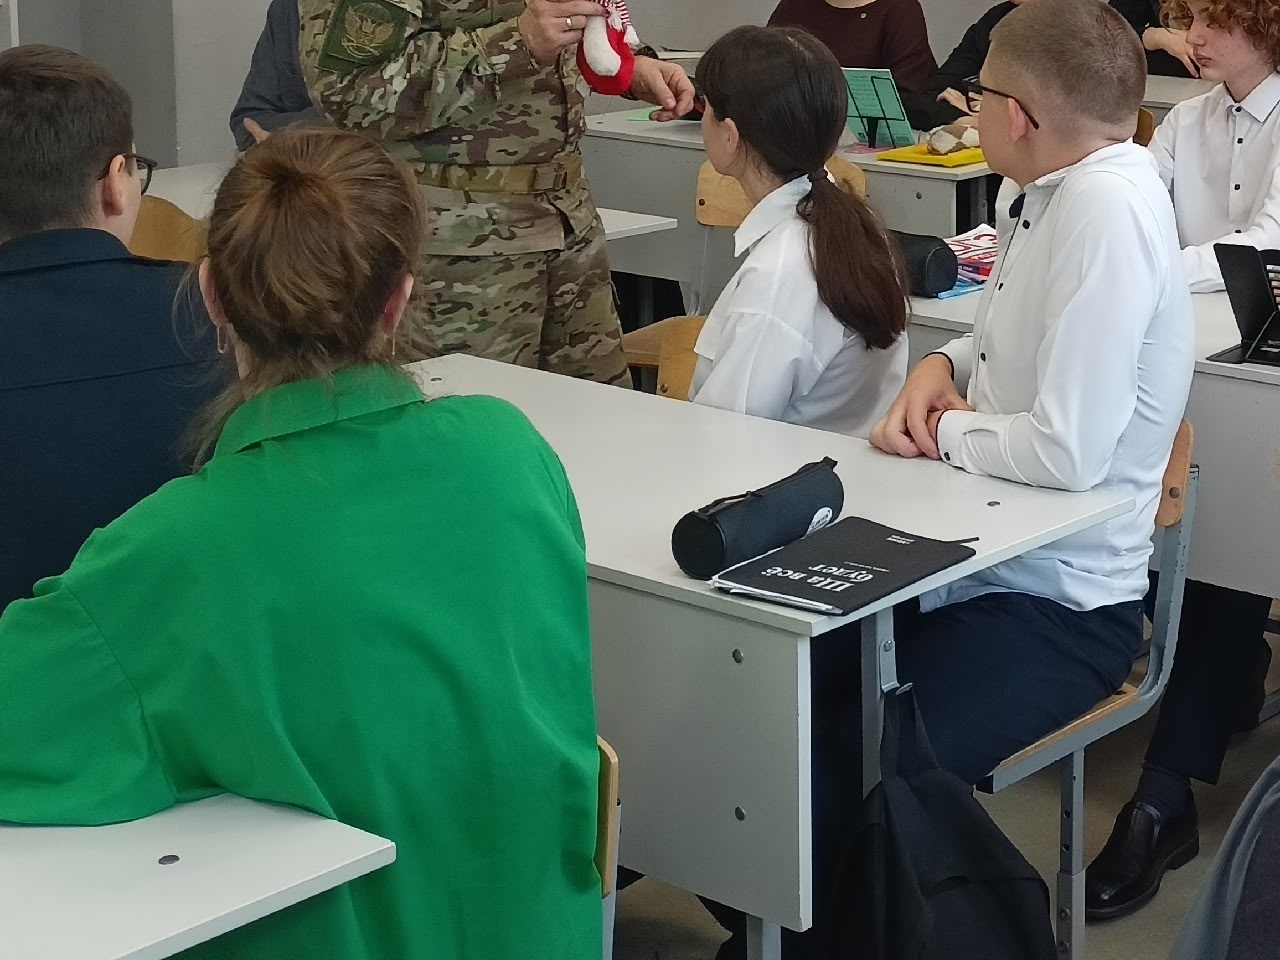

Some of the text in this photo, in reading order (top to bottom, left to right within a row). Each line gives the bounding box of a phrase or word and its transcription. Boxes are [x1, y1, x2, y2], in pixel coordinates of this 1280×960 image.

[761, 566, 855, 592] Ща всё
[808, 564, 874, 582] будет
